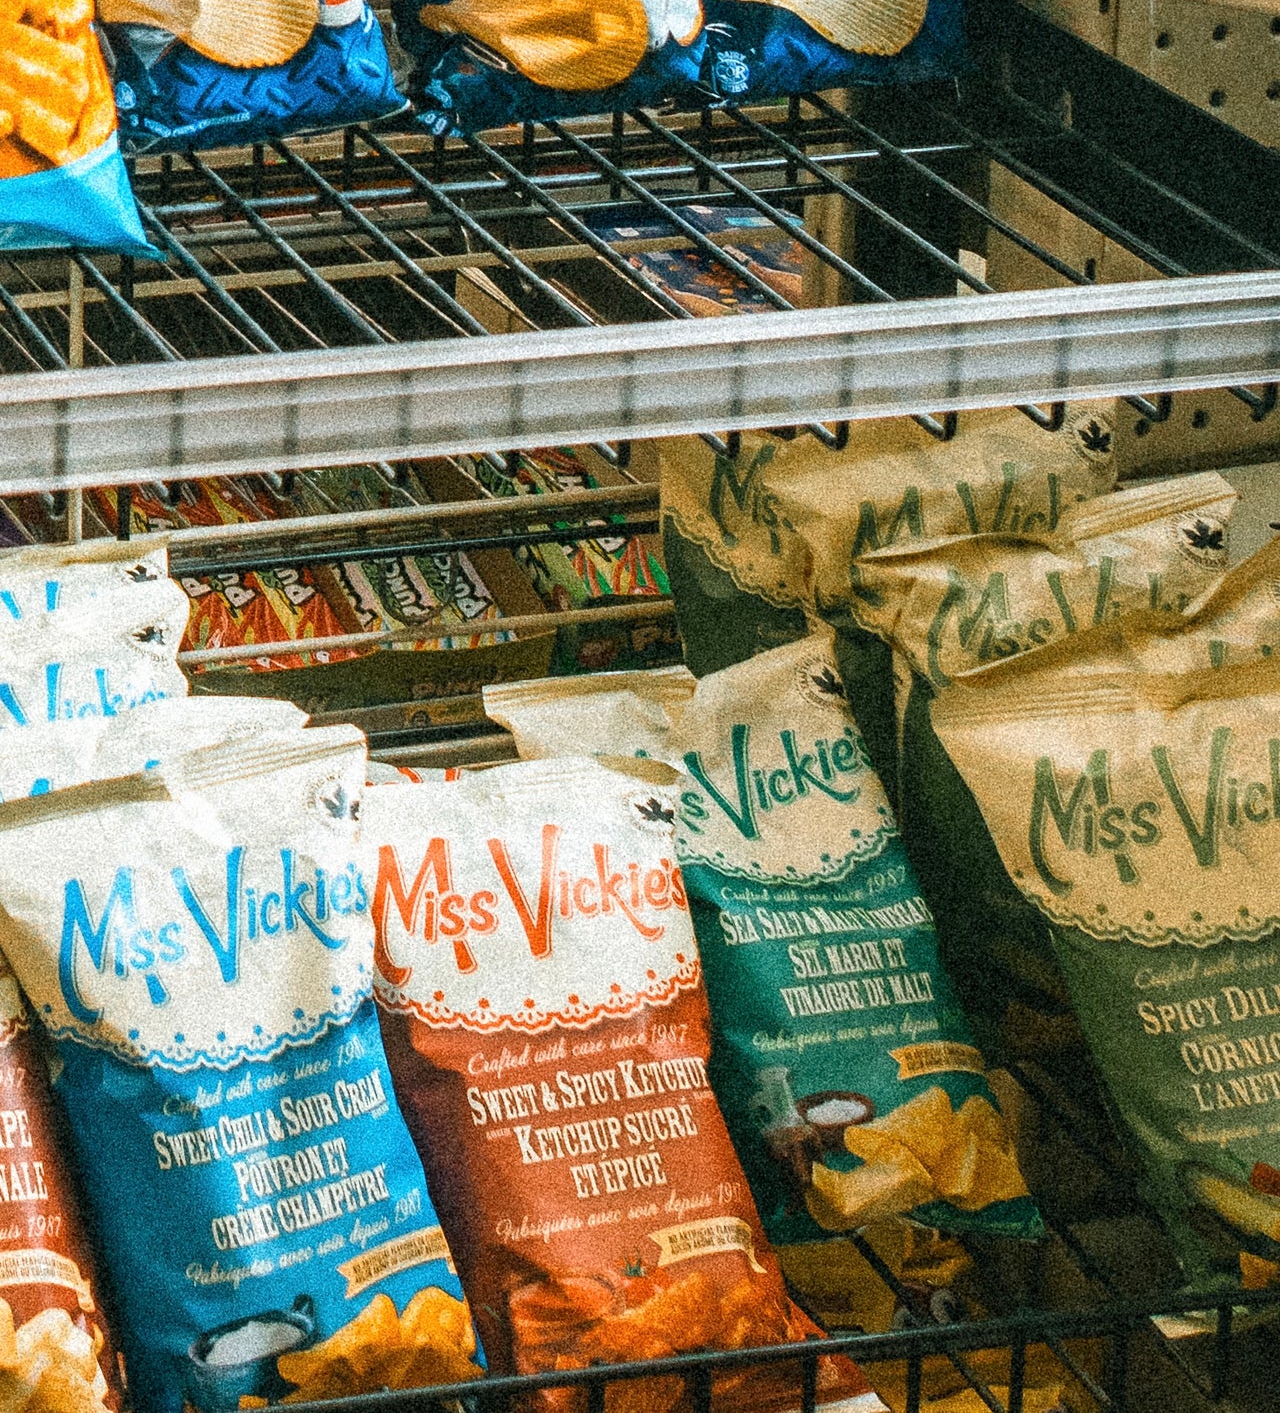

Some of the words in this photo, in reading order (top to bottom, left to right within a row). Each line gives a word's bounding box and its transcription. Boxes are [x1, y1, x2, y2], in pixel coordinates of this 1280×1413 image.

[1028, 748, 1162, 897] Miss
[372, 835, 500, 987] Miss
[486, 822, 689, 961] Vickie's
[719, 908, 761, 946] SEA
[756, 905, 805, 940] SALT
[58, 865, 188, 1024] Miss
[171, 844, 371, 984] Vickie's
[789, 941, 828, 979] SEL
[825, 939, 884, 975] MARIN
[882, 937, 908, 968] ET
[779, 978, 864, 1018] VINAIGRE
[862, 977, 890, 1007] DE
[888, 971, 935, 1005] MALT
[1138, 996, 1223, 1036] SPICY
[293, 1059, 332, 1081] since
[467, 1048, 529, 1080] Crafted
[533, 1037, 567, 1066] with
[571, 1043, 606, 1058] care
[609, 1029, 647, 1051] since
[650, 1023, 688, 1048] 1987
[152, 1125, 221, 1172] SWEET
[218, 1110, 269, 1157] CHILI
[265, 1108, 285, 1143] &
[279, 1092, 340, 1139] SOUR
[334, 1067, 388, 1120] CREAM
[465, 1082, 540, 1127] SWEET
[540, 1083, 560, 1113] &
[555, 1067, 620, 1111] SPICY
[513, 1115, 623, 1165] KETCHUP
[622, 1095, 699, 1147] SUCRÉ
[233, 1151, 325, 1203] POIVRON
[324, 1136, 350, 1178] ET
[570, 1162, 602, 1199] ET
[600, 1145, 668, 1196] ÉPICÉ
[26, 1215, 62, 1238] 1987
[587, 1210, 624, 1227] avec
[628, 1203, 659, 1221] soin
[664, 1188, 713, 1220] depuis
